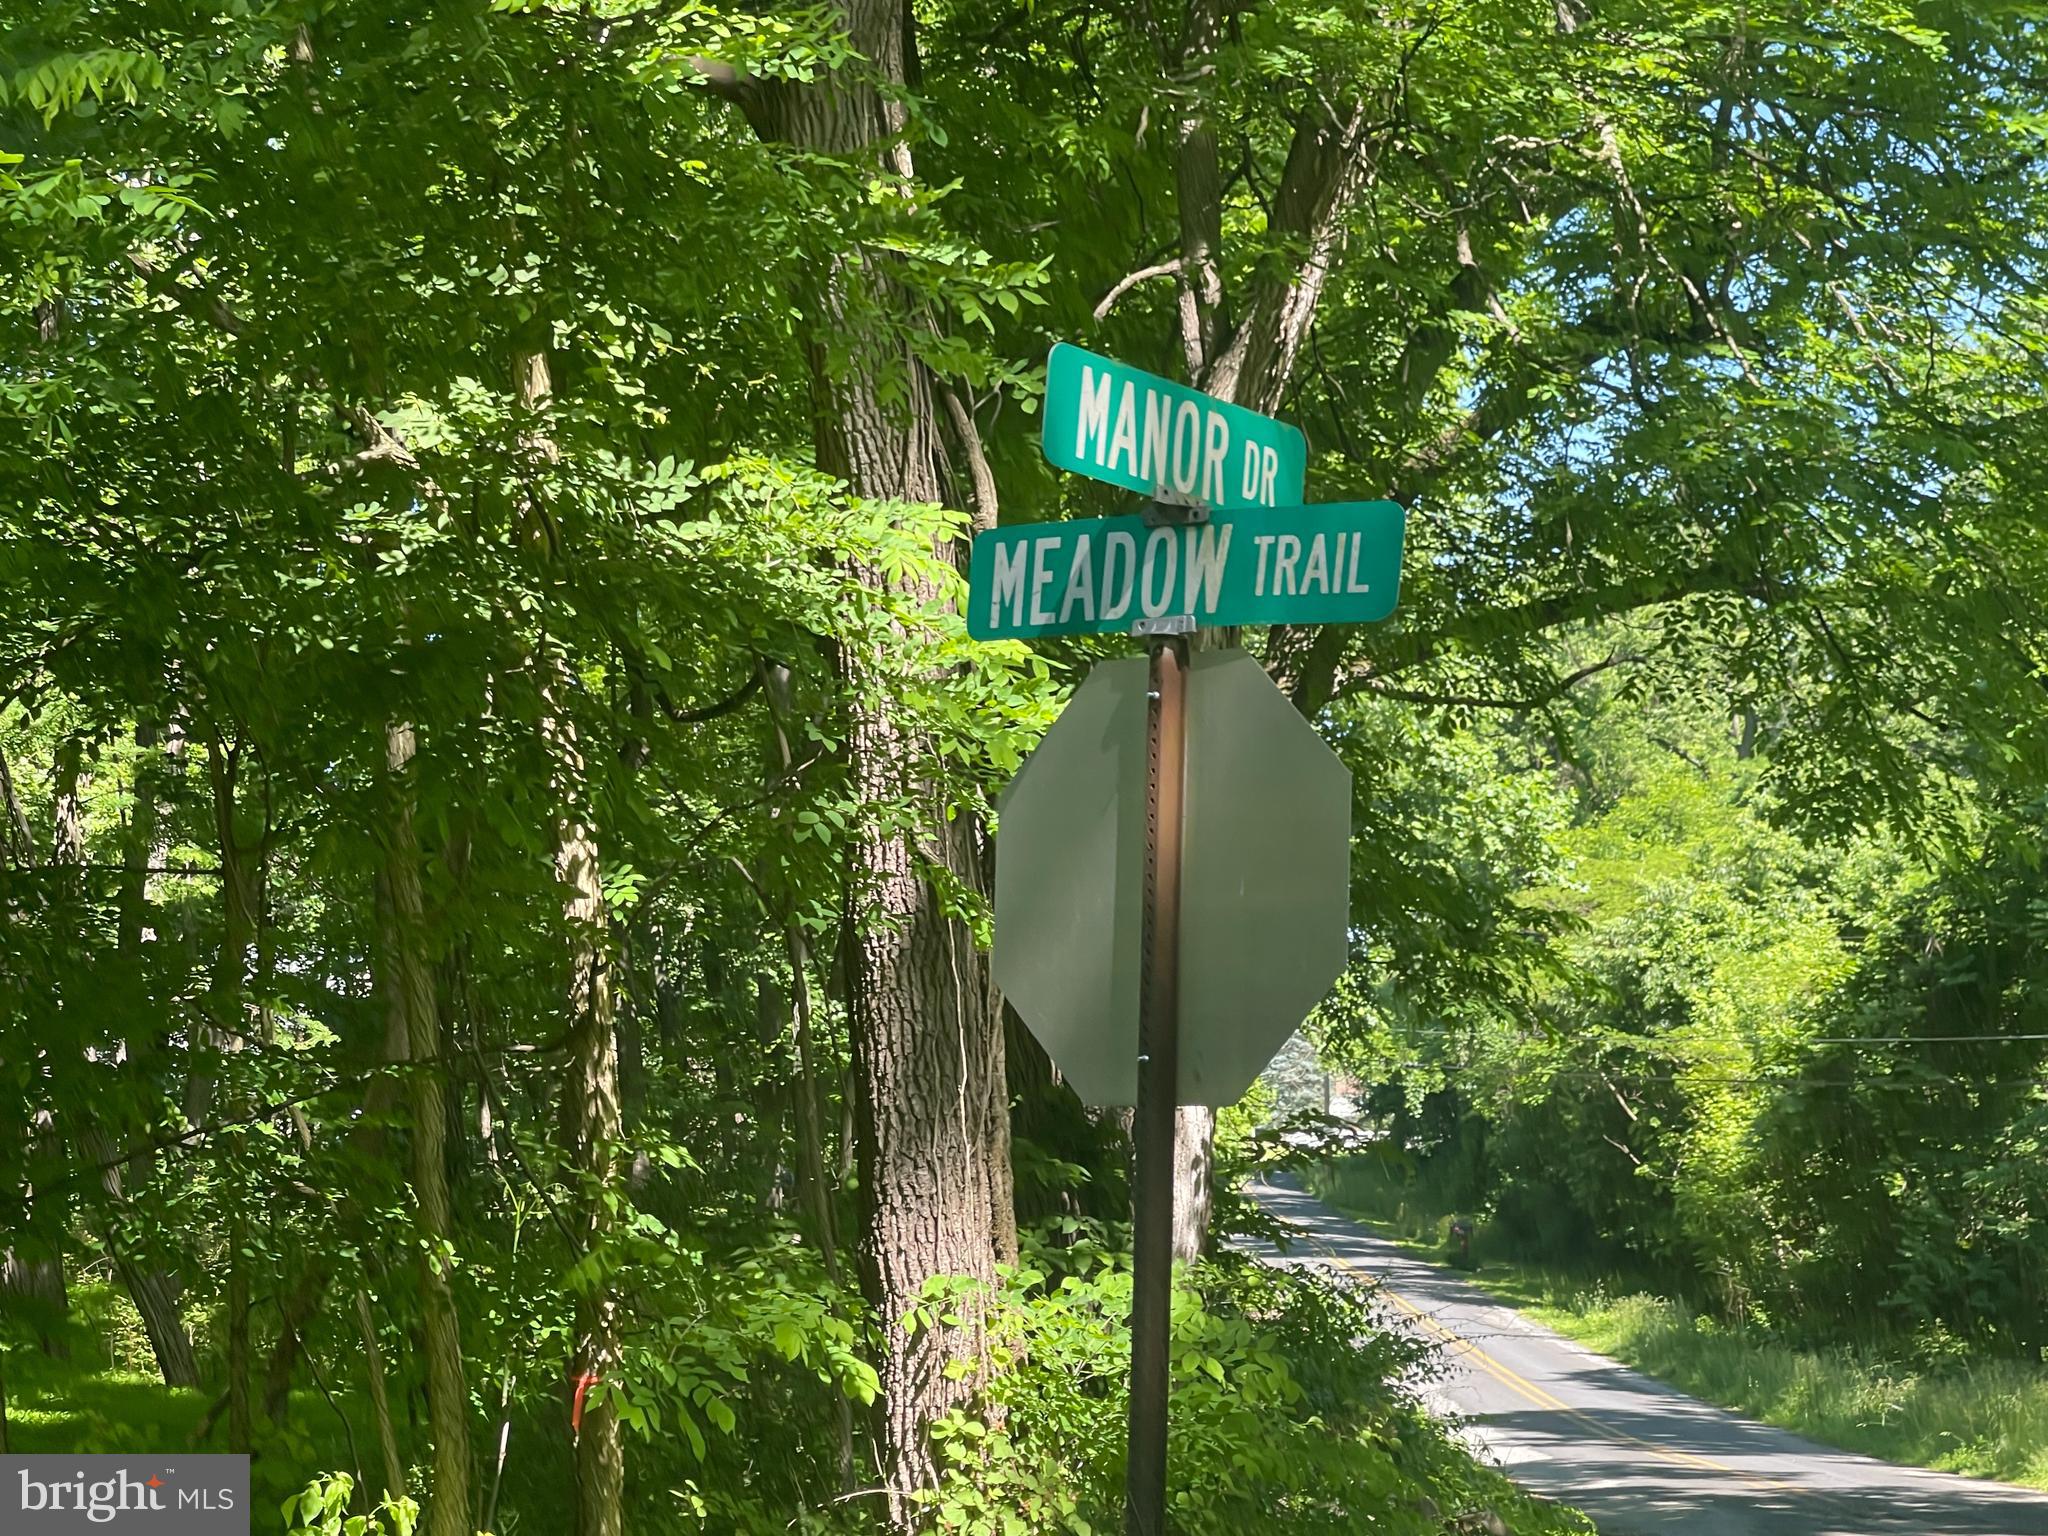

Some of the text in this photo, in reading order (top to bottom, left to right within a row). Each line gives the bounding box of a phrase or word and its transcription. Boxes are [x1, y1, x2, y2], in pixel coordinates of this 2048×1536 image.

[1075, 365, 1278, 507] MANOR DR
[989, 523, 1369, 629] MEADOW TRAIL
